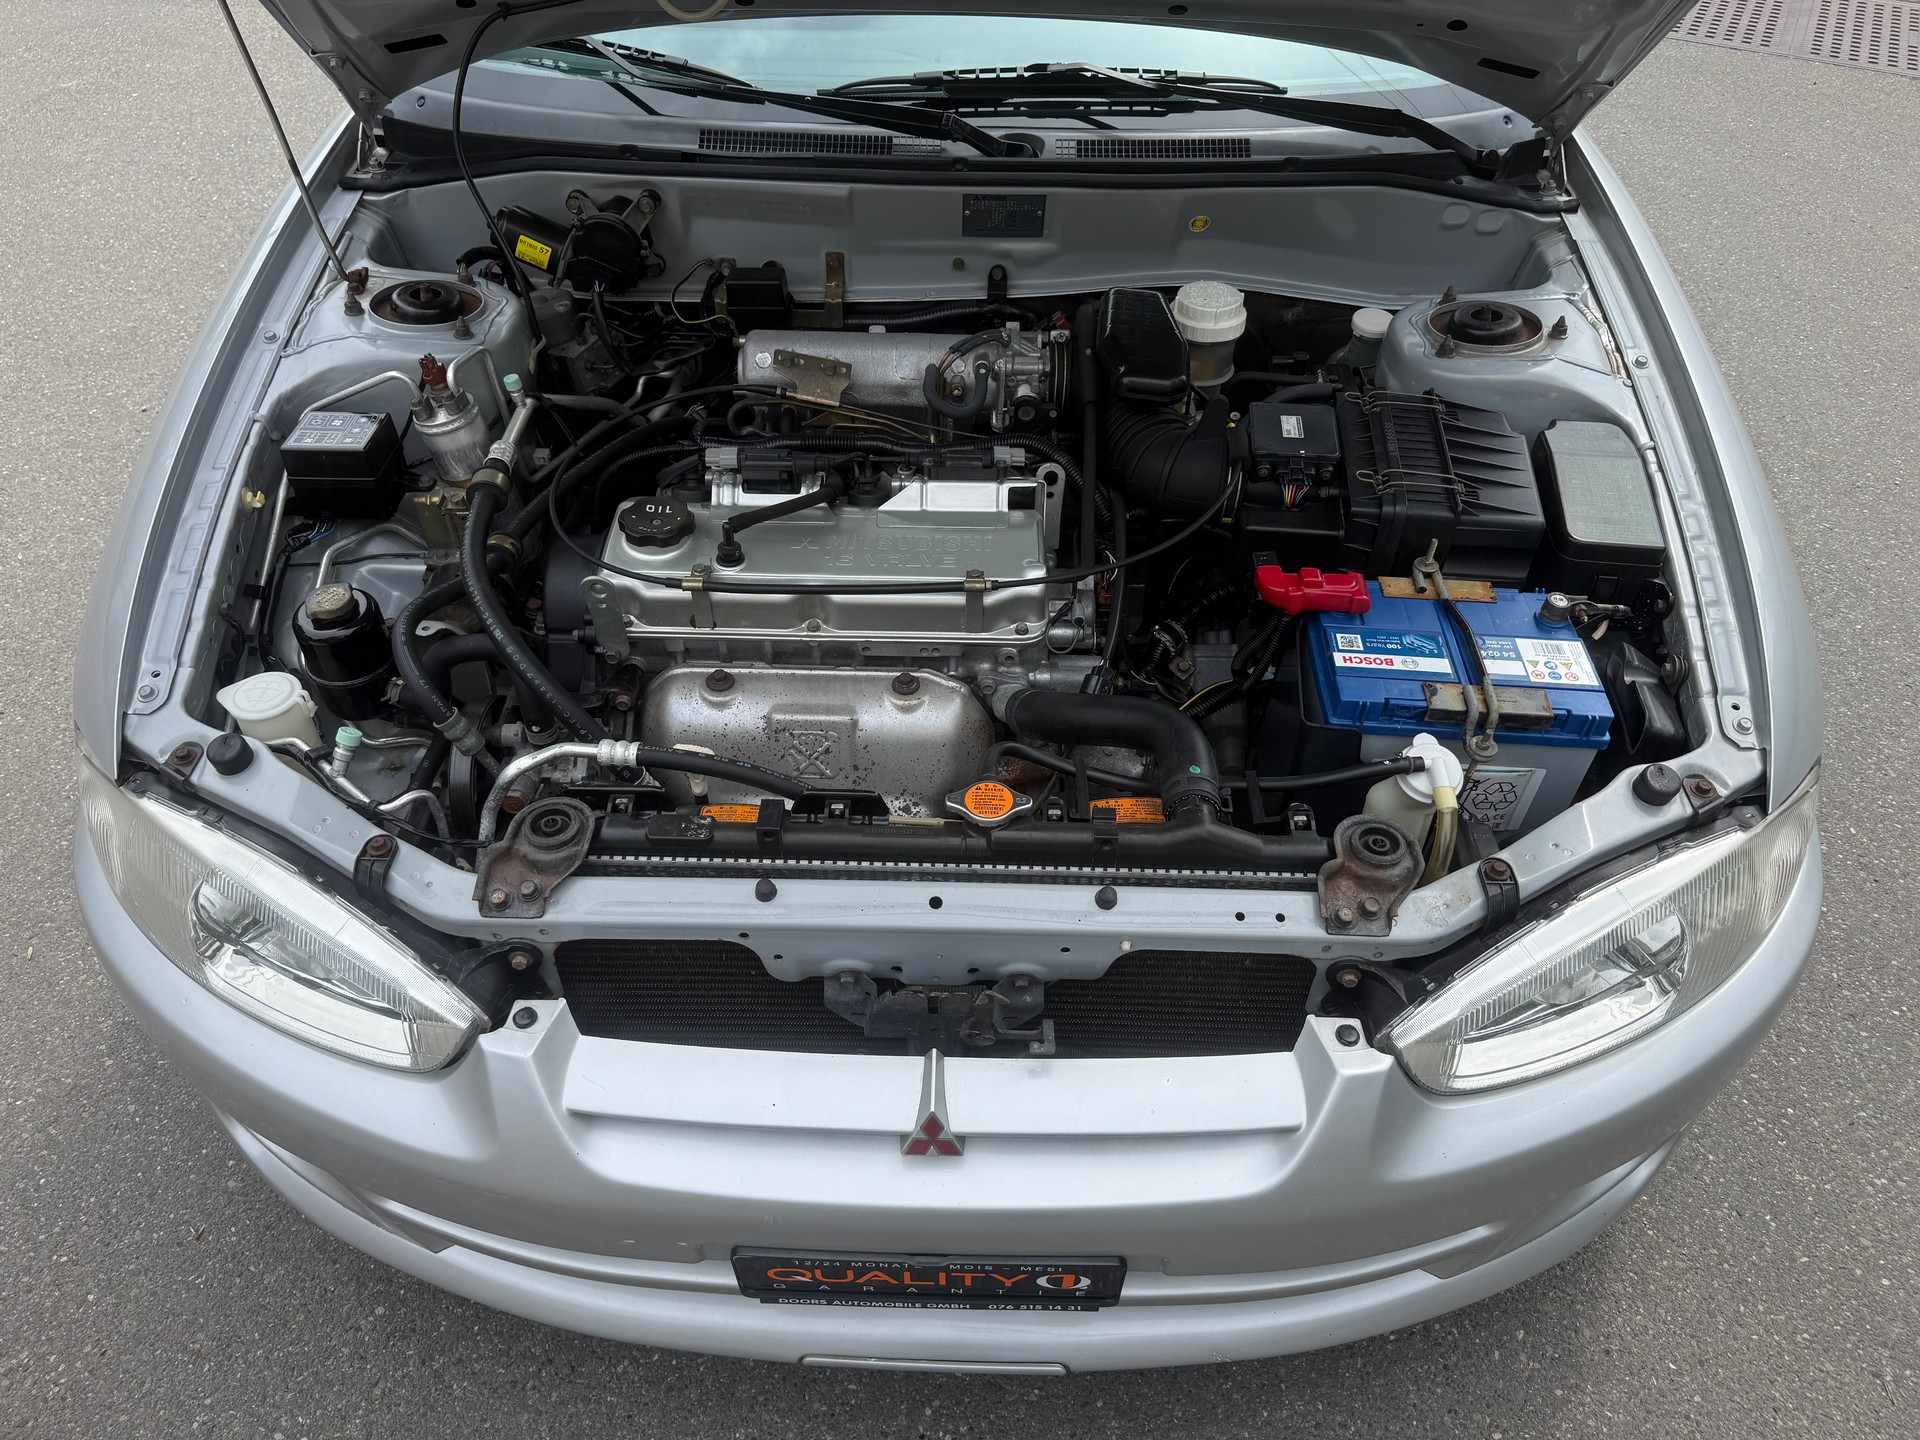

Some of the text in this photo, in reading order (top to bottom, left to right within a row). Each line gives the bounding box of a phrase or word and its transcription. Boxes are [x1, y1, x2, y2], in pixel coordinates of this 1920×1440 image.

[646, 504, 673, 513] OIL
[826, 535, 993, 552] MITSUBISHI
[865, 554, 957, 568] VALVE
[1341, 656, 1395, 667] BOSCH
[767, 1267, 1030, 1288] QUALITY
[779, 1298, 828, 1306] DOORS
[833, 1300, 922, 1309] AUTOMOBILE
